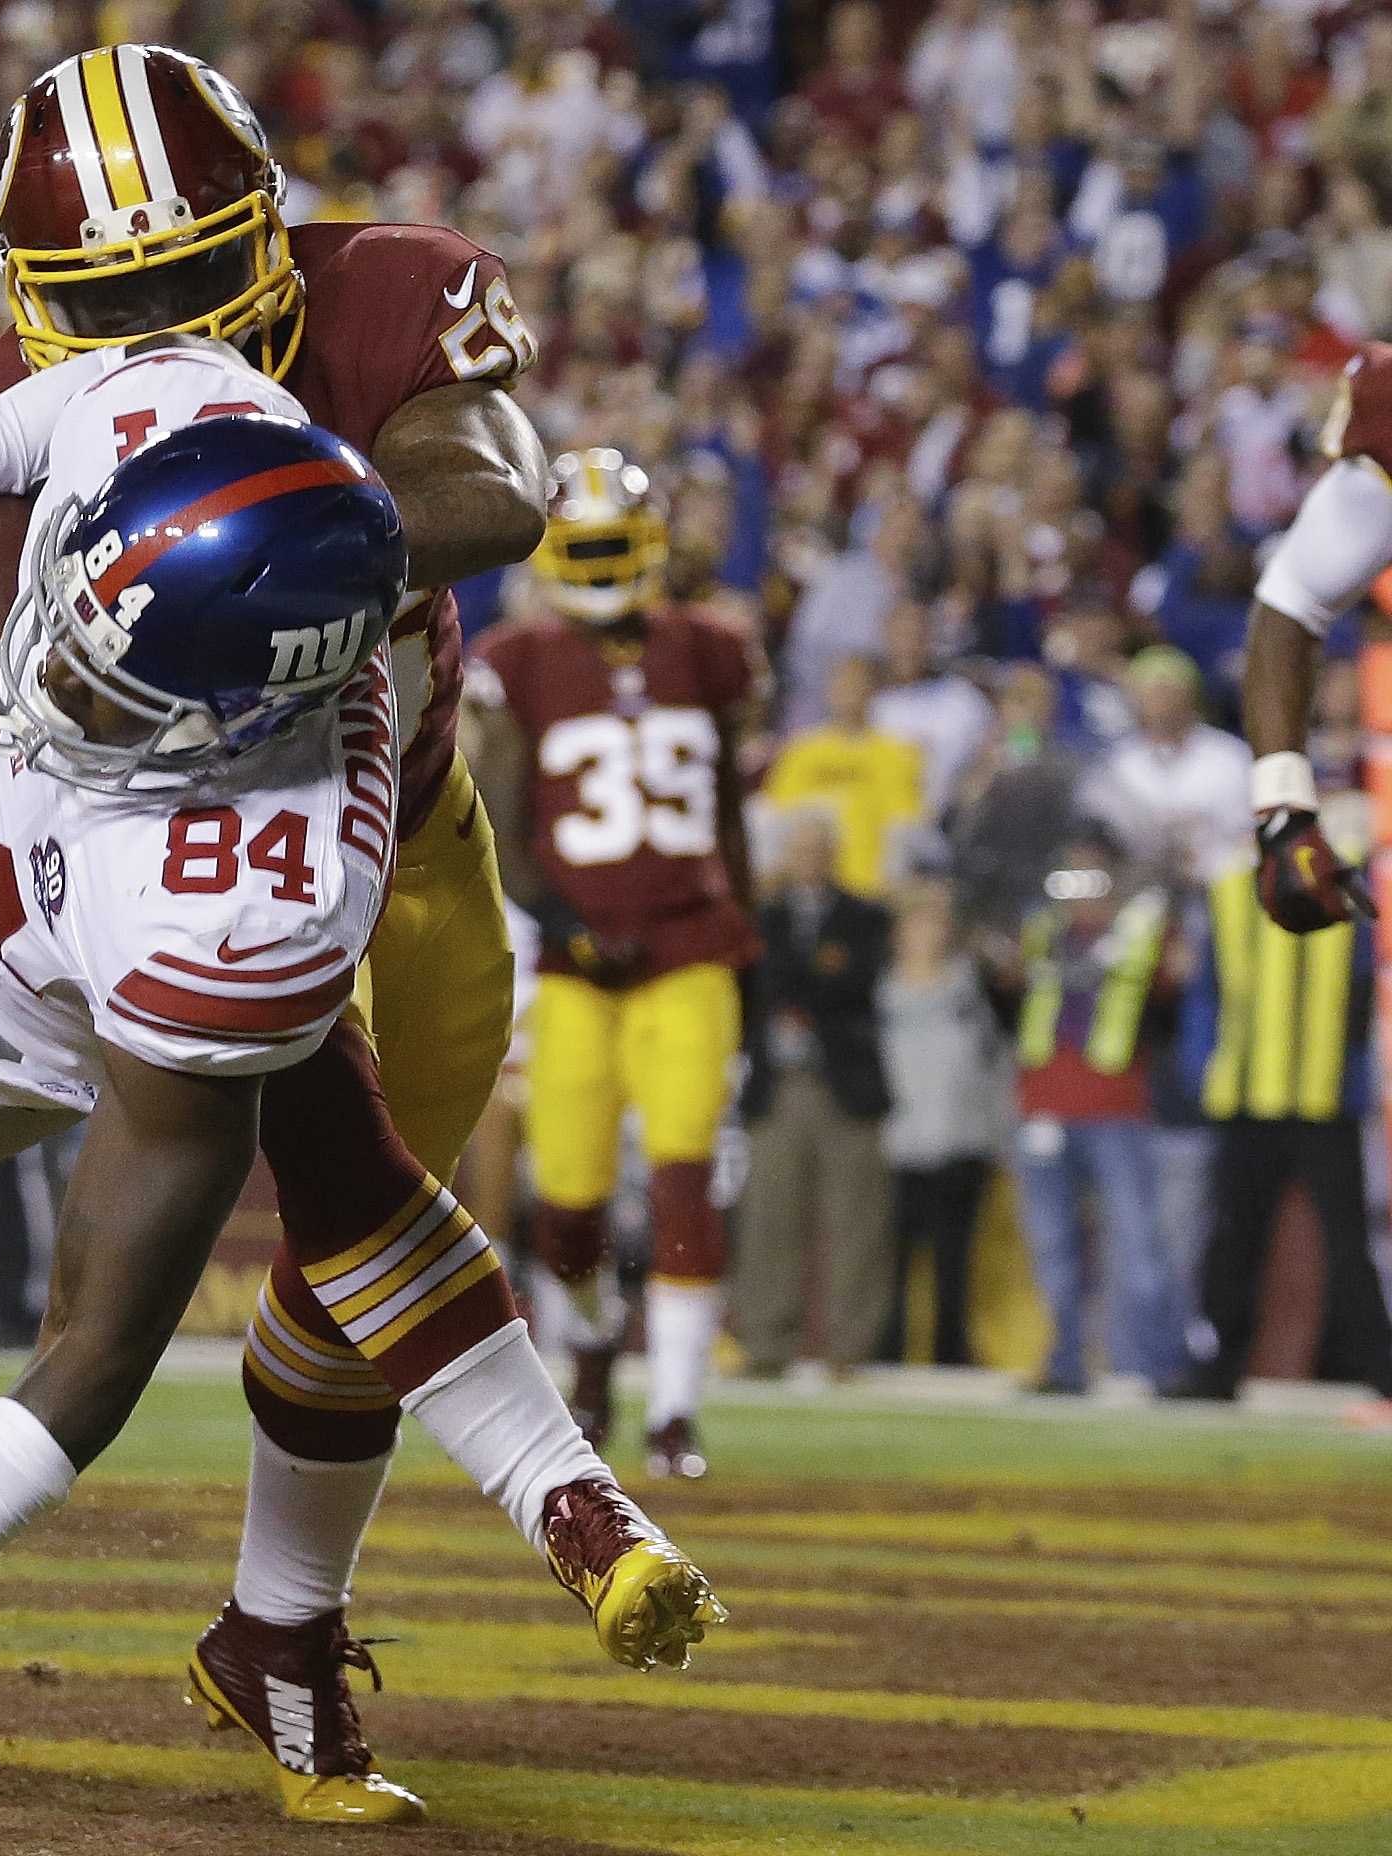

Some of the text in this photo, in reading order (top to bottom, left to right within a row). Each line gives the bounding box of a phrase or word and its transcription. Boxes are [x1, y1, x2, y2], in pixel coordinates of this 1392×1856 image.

[438, 277, 539, 381] 56
[85, 529, 156, 631] 84
[339, 648, 392, 867] DONN
[538, 704, 722, 867] 39
[45, 850, 63, 901] 90
[161, 805, 317, 905] 84
[263, 1673, 315, 1776] NIKE
